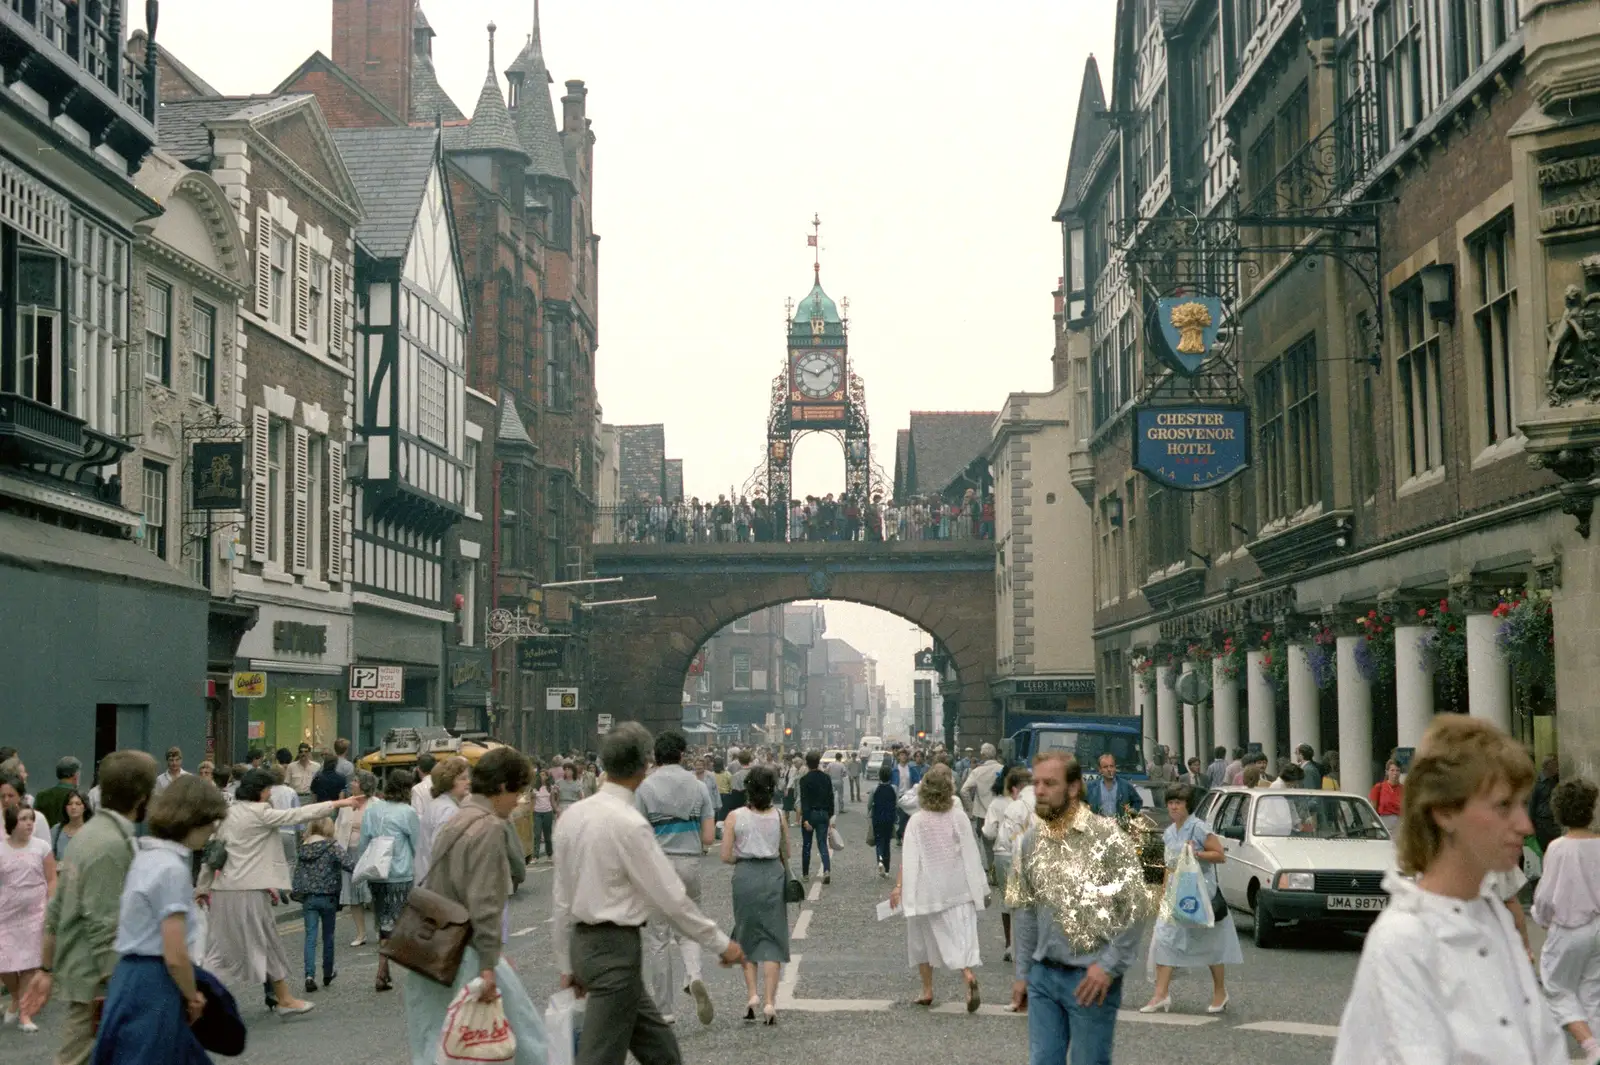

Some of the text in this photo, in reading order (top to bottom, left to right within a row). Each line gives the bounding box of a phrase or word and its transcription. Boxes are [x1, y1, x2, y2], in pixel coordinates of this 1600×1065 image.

[833, 391, 844, 401] 97
[1157, 414, 1224, 425] CHESTER
[1147, 428, 1234, 440] GROSVENOR
[1167, 443, 1216, 455] HOTEL
[351, 688, 401, 700] repairs
[1328, 898, 1385, 908] JMA 987Y
